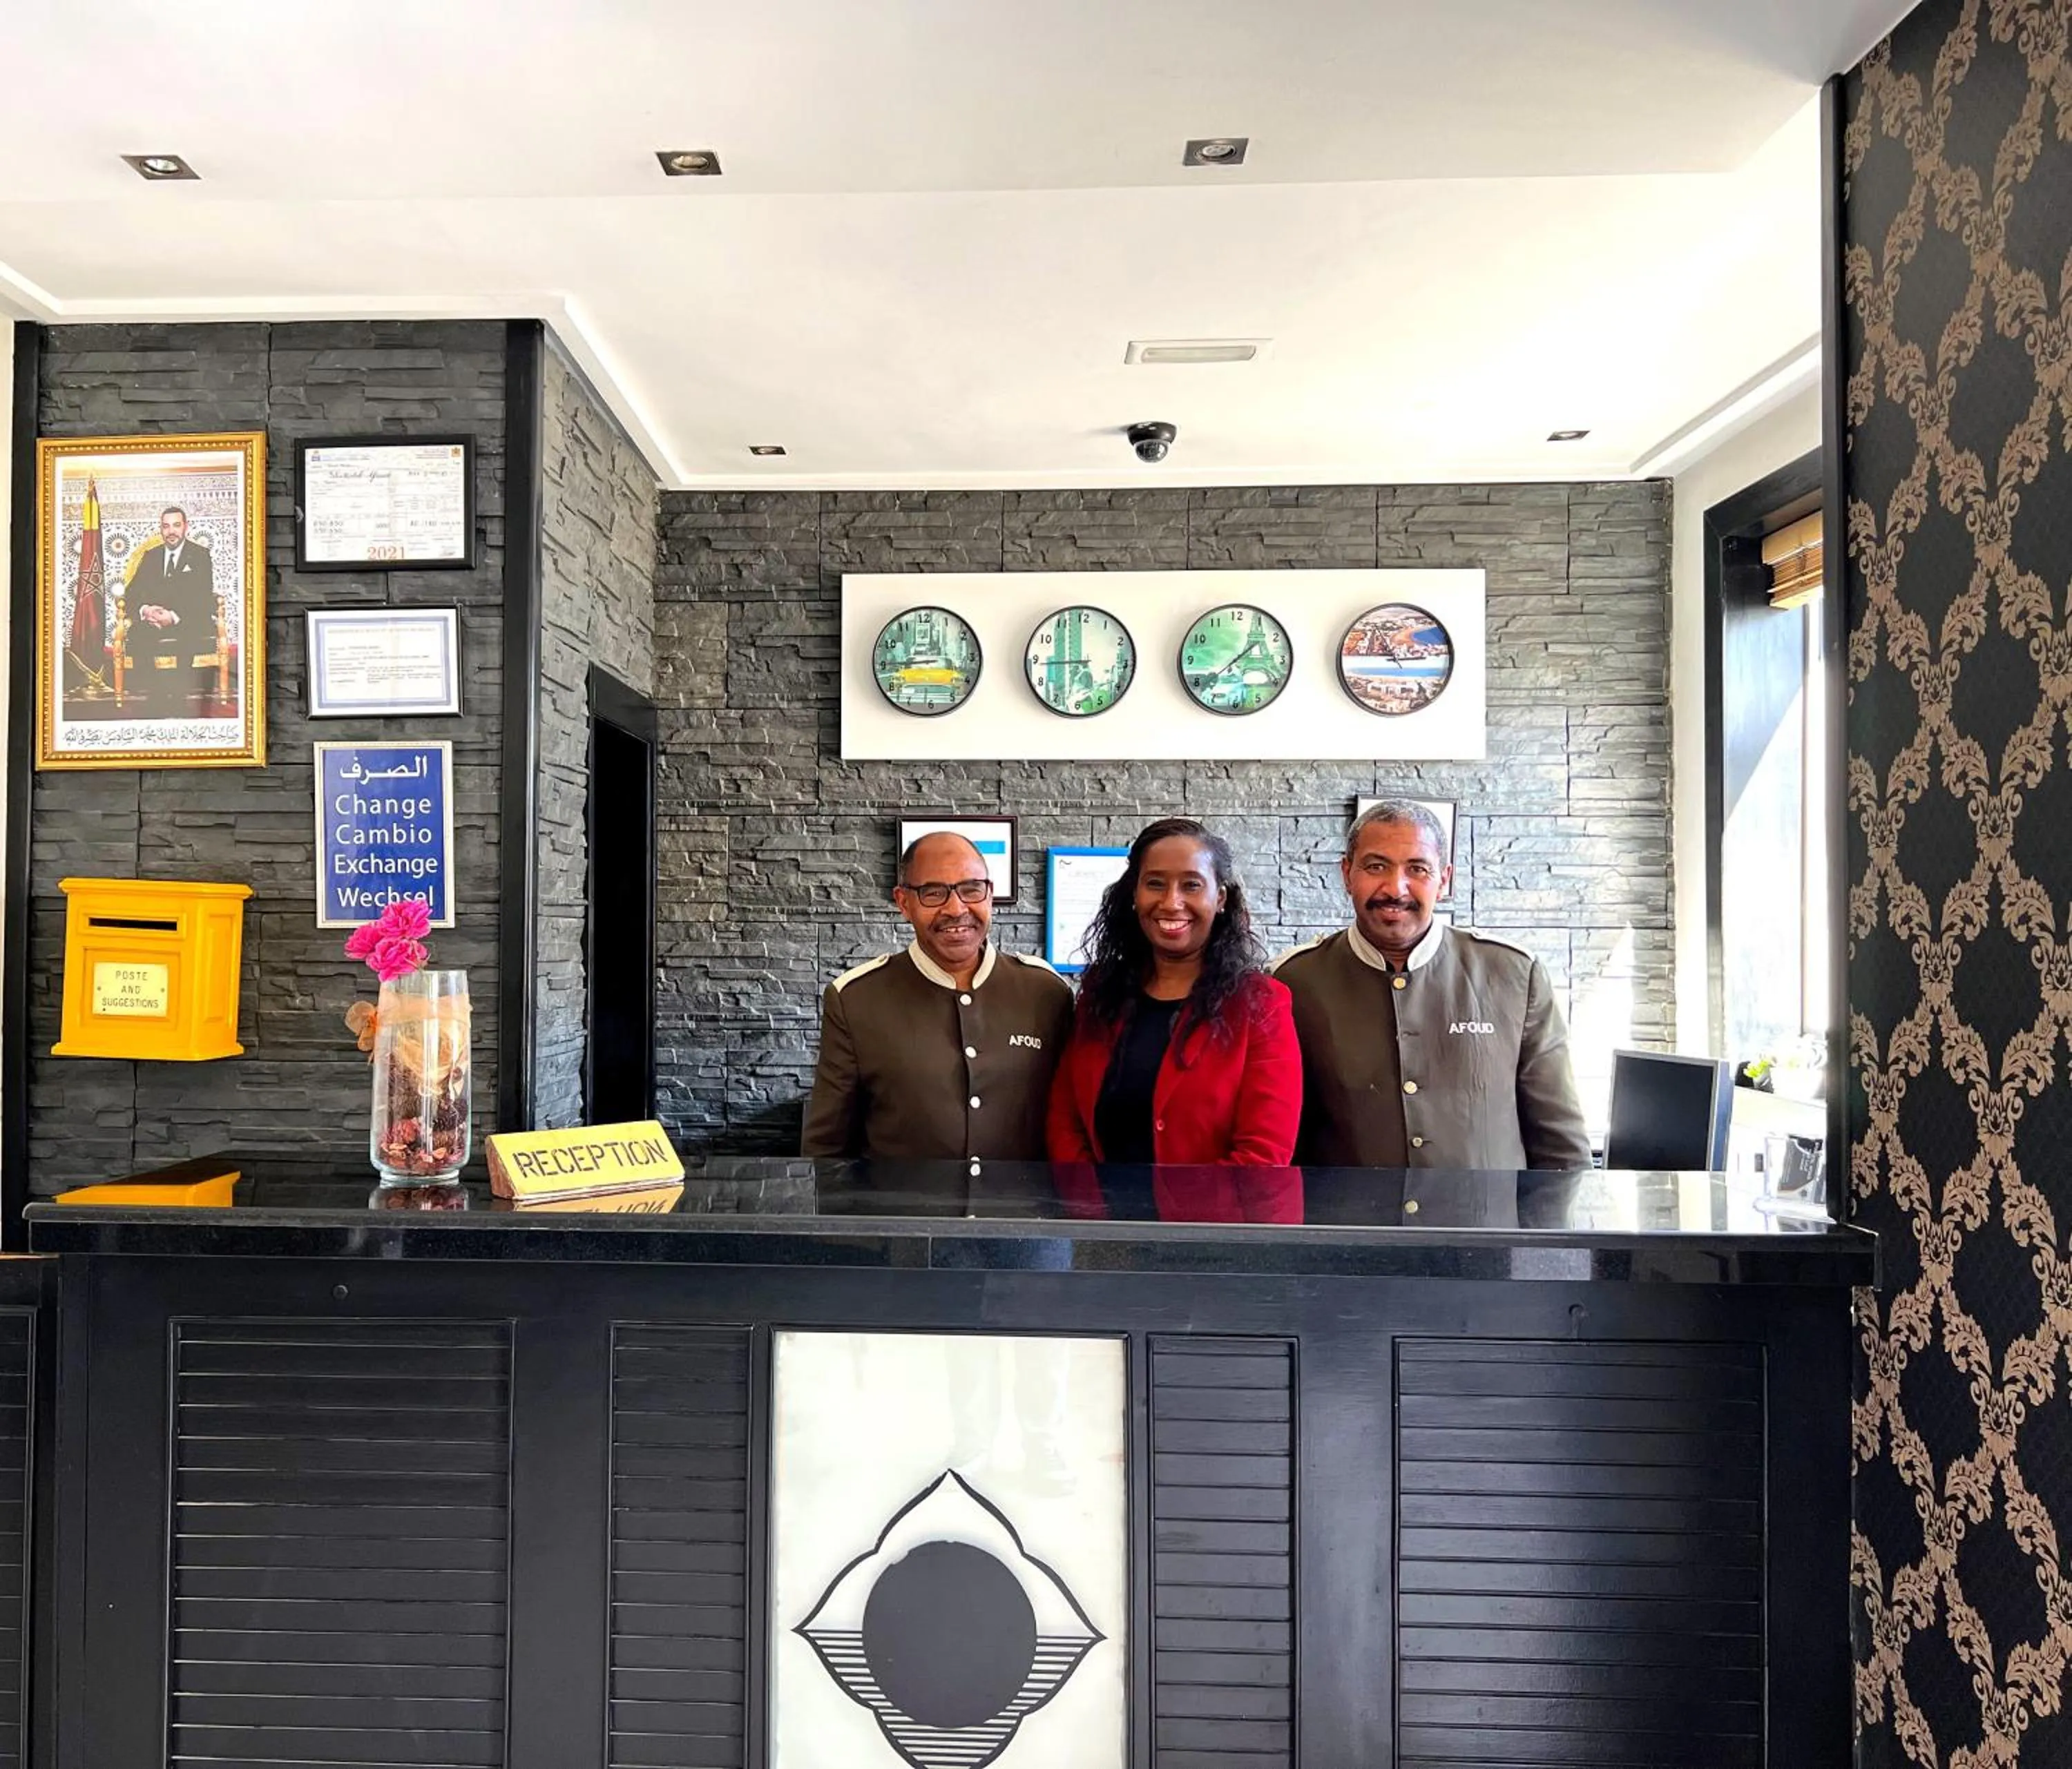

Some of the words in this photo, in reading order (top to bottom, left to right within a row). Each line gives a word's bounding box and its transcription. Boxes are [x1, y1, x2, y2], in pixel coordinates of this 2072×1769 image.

[367, 546, 405, 560] 2021
[918, 613, 930, 623] 12
[1078, 613, 1089, 623] 12
[1231, 611, 1243, 621] 12
[899, 621, 909, 631] 11
[1057, 618, 1067, 628] 11
[1211, 618, 1220, 628] 11
[961, 631, 967, 641] 2
[1040, 634, 1052, 644] 10
[1194, 634, 1206, 644] 10
[1273, 633, 1279, 642] 2
[885, 640, 896, 649] 10
[1117, 637, 1124, 646] 2
[1033, 655, 1039, 664] 9
[1123, 660, 1128, 669] 3
[1187, 655, 1193, 665] 9
[1280, 655, 1285, 665] 3
[1037, 677, 1044, 686] 8
[1194, 677, 1200, 687] 8
[950, 693, 955, 702] 5
[1097, 696, 1103, 705] 5
[1256, 694, 1261, 703] 5
[928, 700, 934, 709] 6
[1075, 701, 1081, 710] 6
[339, 755, 428, 785] الصرف
[335, 794, 432, 820] Change
[336, 823, 432, 844] Cambio
[334, 853, 438, 879] Exchange
[115, 970, 148, 981] POSTE
[121, 985, 142, 994] AND
[102, 997, 159, 1009] SUGGESTIONS
[1449, 1021, 1495, 1034] AFOUD
[1009, 1035, 1042, 1050] AFOUD
[512, 1139, 669, 1178] RECEPTION
